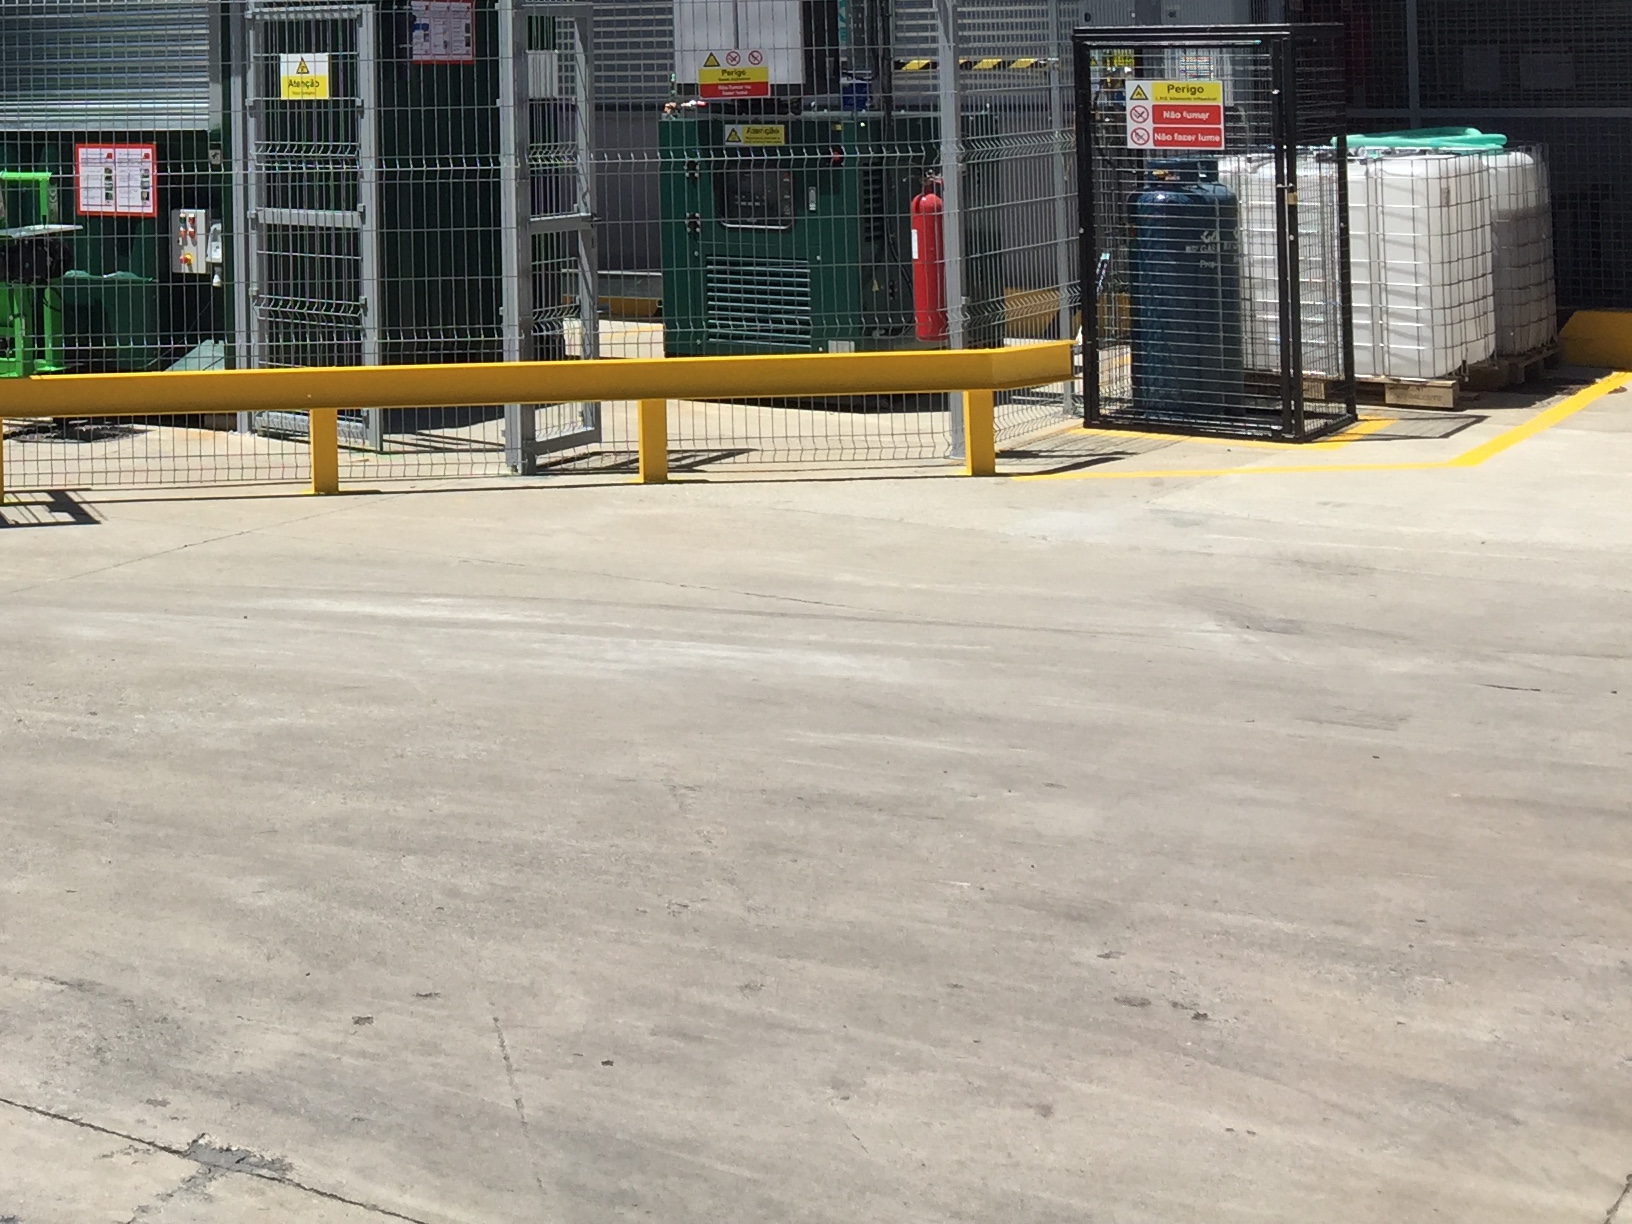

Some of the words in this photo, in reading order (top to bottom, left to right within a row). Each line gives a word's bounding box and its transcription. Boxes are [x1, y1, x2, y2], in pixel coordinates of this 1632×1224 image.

[1167, 84, 1204, 96] Perigo
[1162, 110, 1181, 119] Não
[1183, 110, 1210, 120] fumar
[1154, 132, 1172, 141] Não
[1174, 132, 1196, 142] fazer
[1198, 132, 1220, 141] lume
